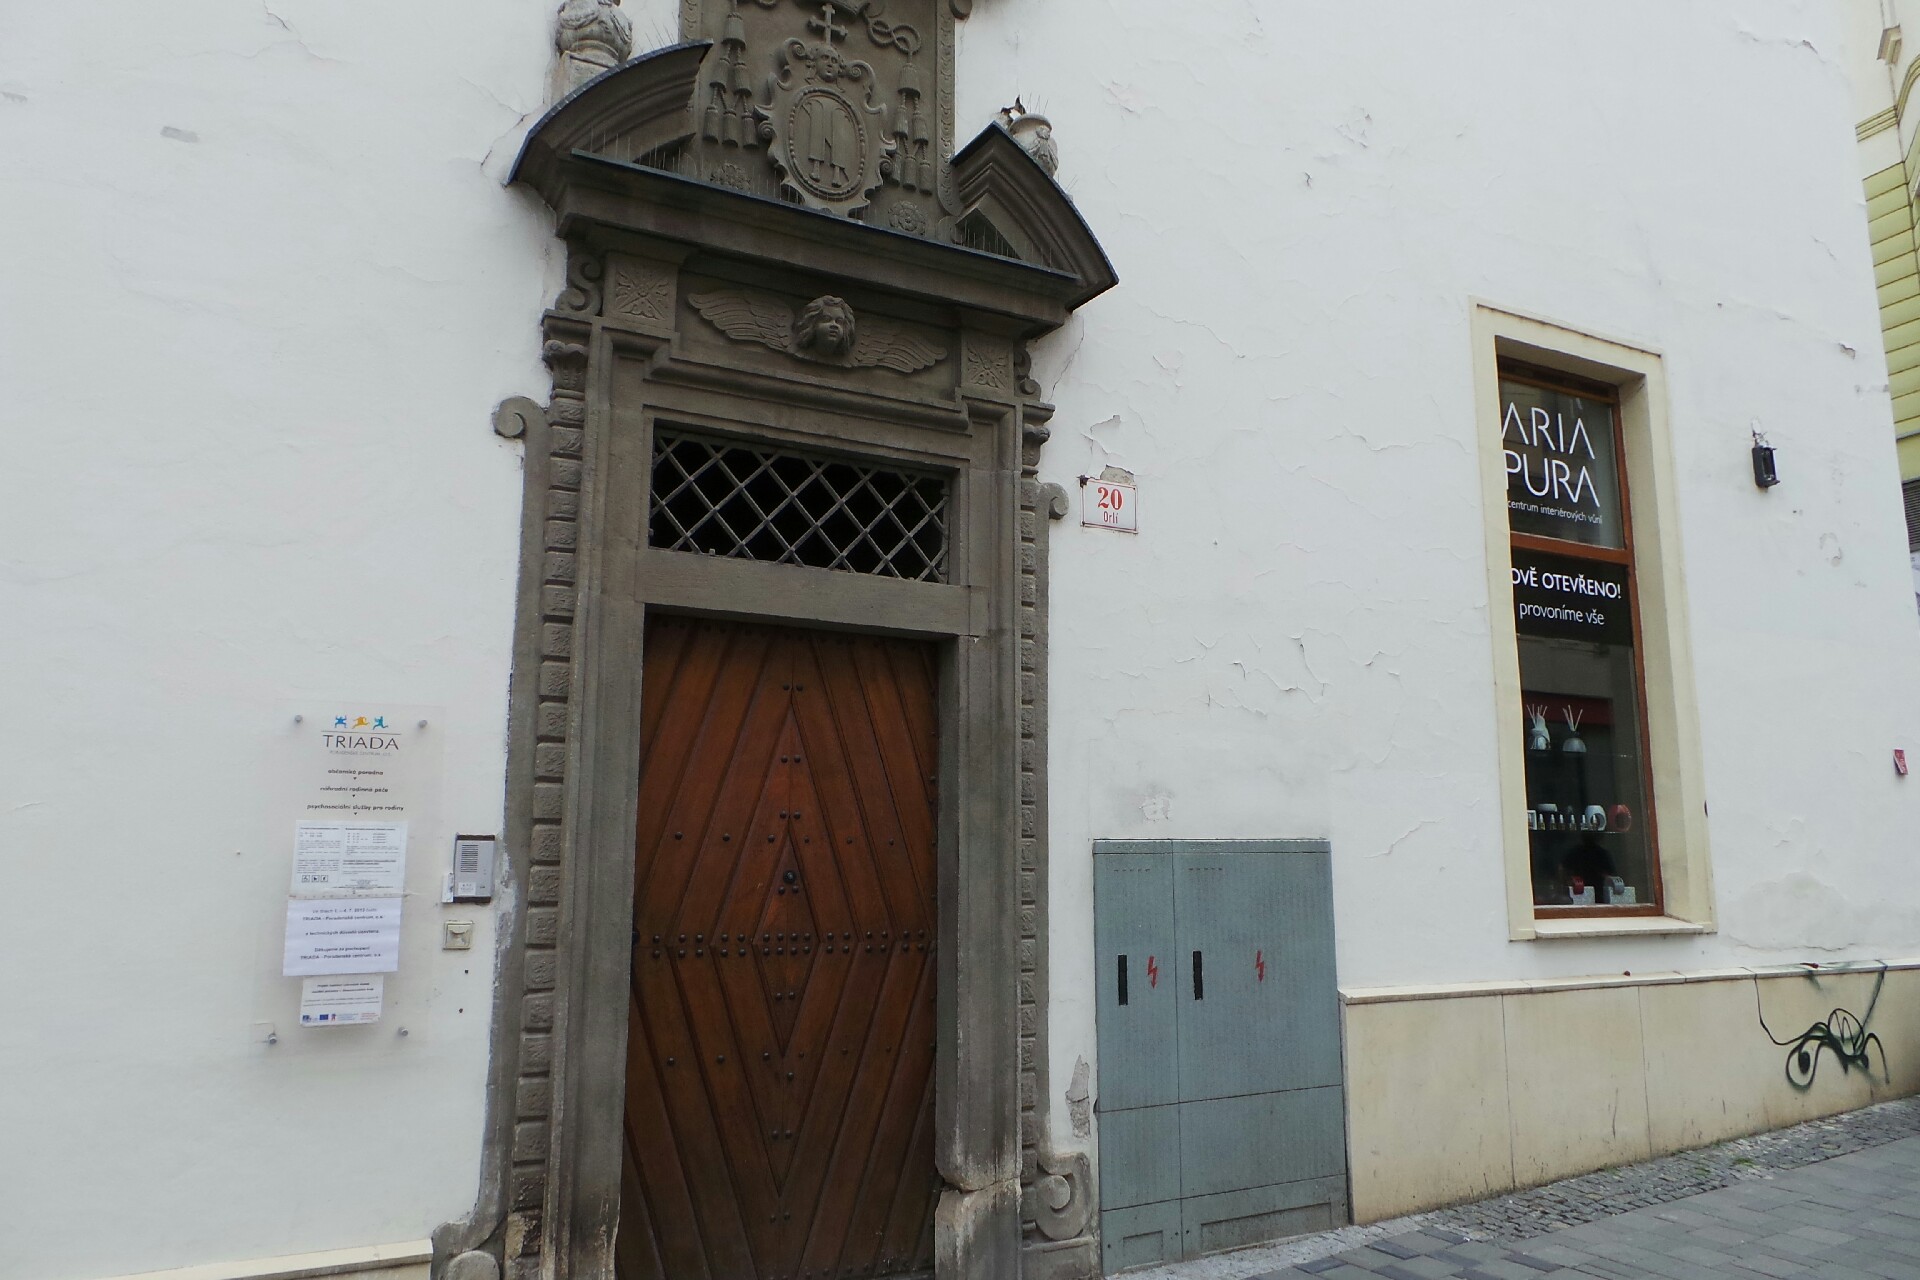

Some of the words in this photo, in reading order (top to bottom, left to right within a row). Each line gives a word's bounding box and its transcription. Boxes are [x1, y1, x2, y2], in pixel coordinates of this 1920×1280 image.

[1501, 402, 1595, 459] ARIA
[1503, 449, 1600, 507] PURA
[1097, 487, 1123, 510] 20
[1507, 500, 1539, 513] centrum
[1103, 511, 1119, 524] Orlí
[1510, 566, 1539, 587] OVĚ
[1542, 573, 1622, 599] OTEVŘENO!
[1519, 603, 1584, 623] provoníme
[1585, 608, 1605, 625] vše
[322, 734, 399, 750] TRIADA
